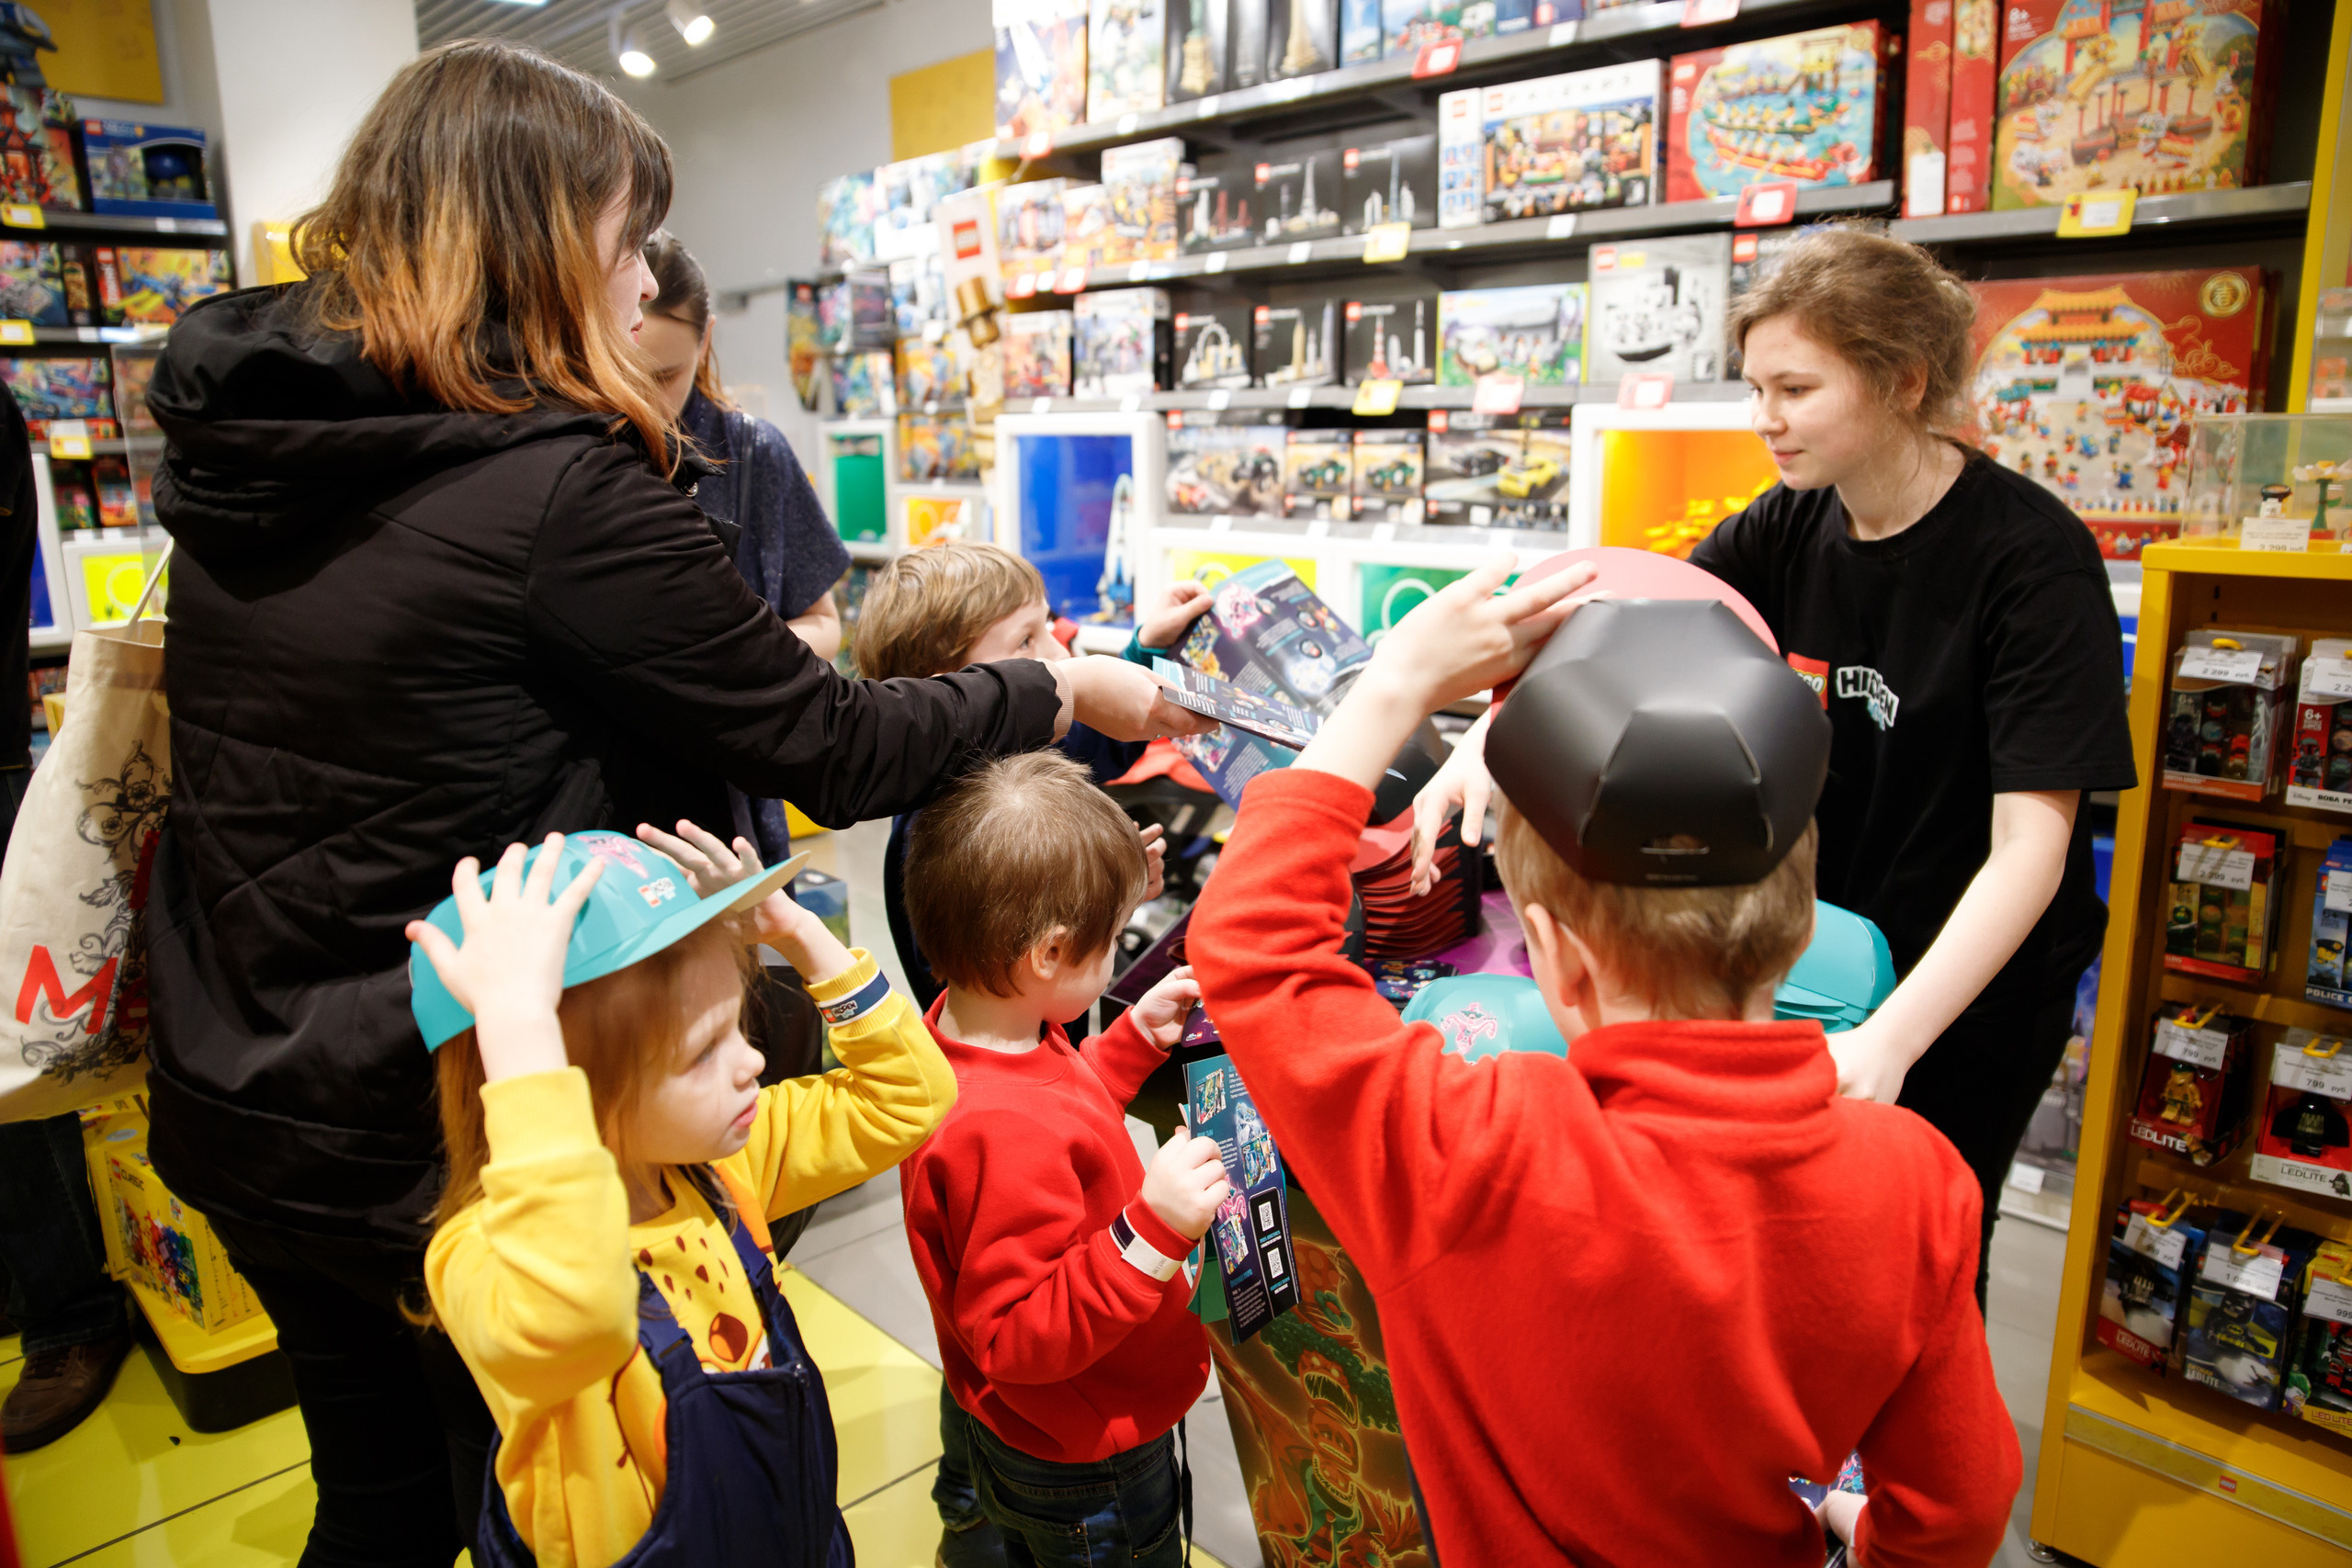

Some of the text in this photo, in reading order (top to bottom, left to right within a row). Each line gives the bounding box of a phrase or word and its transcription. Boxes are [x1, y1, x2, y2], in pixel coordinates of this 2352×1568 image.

[2304, 708, 2323, 721] 6+
[2318, 794, 2340, 803] BOBA
[2305, 987, 2345, 1001] POLICE
[2306, 1077, 2324, 1089] 799
[2131, 1123, 2188, 1153] LEDLITE
[2280, 1167, 2328, 1183] LEDLITE
